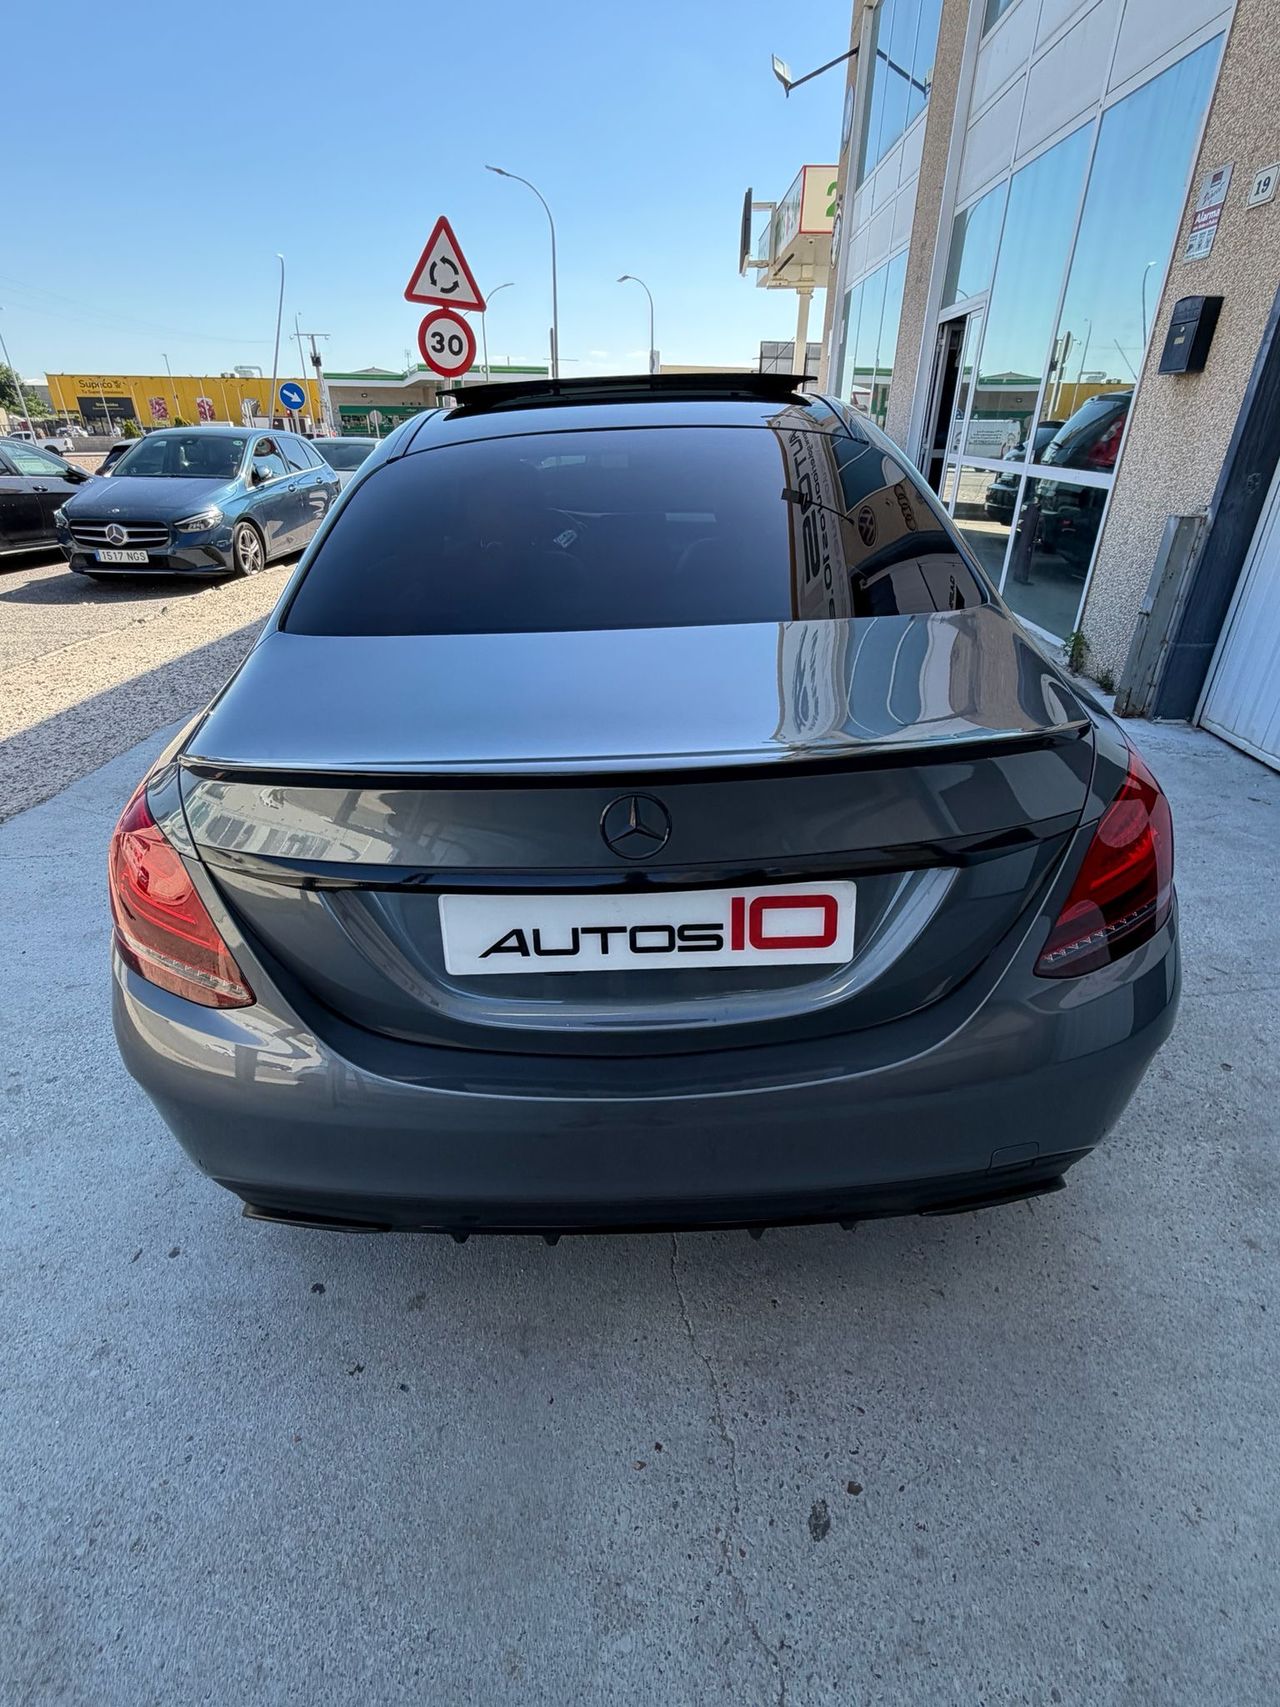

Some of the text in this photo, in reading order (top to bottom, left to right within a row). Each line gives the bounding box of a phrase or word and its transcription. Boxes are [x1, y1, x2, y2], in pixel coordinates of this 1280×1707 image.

[1254, 176, 1271, 196] 19
[1194, 208, 1221, 225] Alarma
[430, 331, 464, 357] 30
[101, 551, 147, 561] 1517 NGS
[478, 894, 839, 959] AUTOS10
